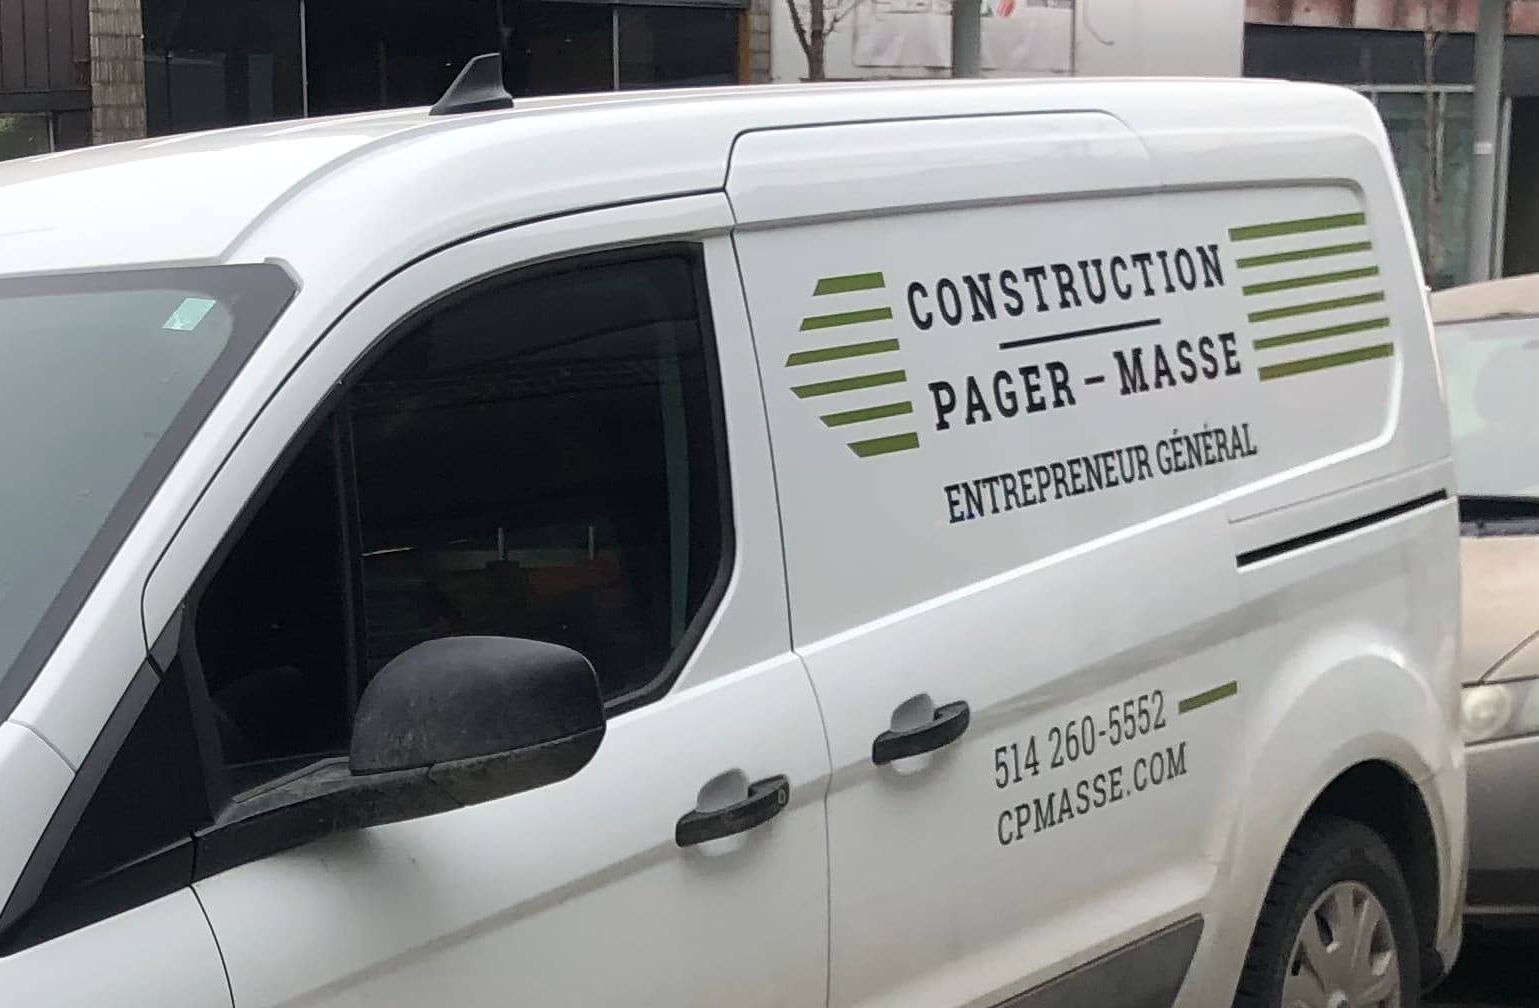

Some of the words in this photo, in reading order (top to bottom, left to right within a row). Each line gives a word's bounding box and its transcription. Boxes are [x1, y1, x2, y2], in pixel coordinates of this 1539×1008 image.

[906, 242, 1226, 330] CONSTRUCTION
[944, 443, 1152, 524] ENTREPRENEUR
[1155, 423, 1258, 476] GÉNÉRAL
[994, 735, 1039, 789] 514
[1048, 690, 1166, 769] 260-5552
[997, 741, 1188, 846] CPMASSE.COM
